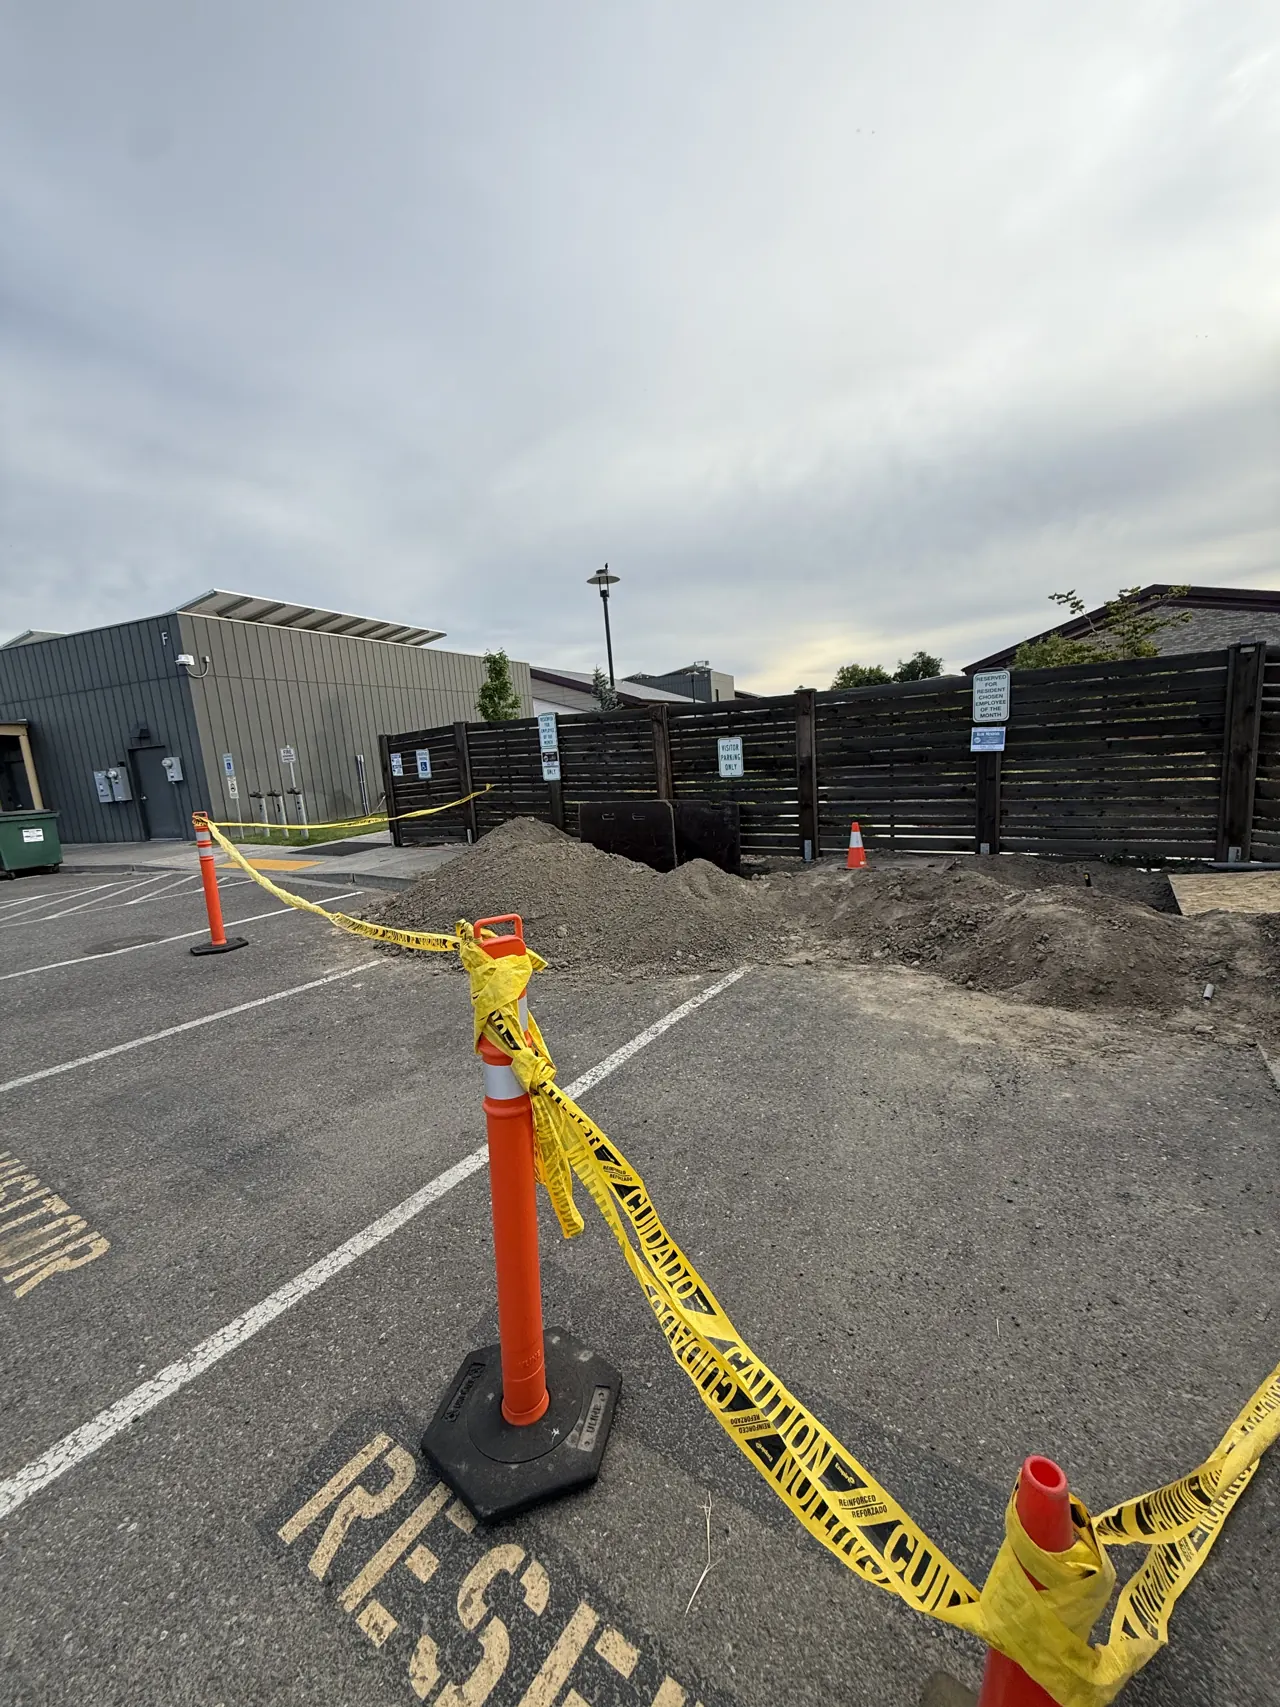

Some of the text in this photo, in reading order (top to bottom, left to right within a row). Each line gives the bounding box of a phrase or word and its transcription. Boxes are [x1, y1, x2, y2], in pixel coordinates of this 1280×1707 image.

[161, 631, 168, 646] F
[622, 1187, 698, 1300] CUIDADO
[586, 1403, 602, 1433] ULINE
[722, 1345, 836, 1479] CAUTION
[730, 1413, 761, 1425] REFORZADO
[738, 1423, 772, 1434] REINFORCED
[838, 1494, 877, 1507] REINFORCED
[851, 1504, 888, 1518] REFORZADO
[277, 1432, 706, 1707] RESE
[883, 1524, 969, 1612] CUID
